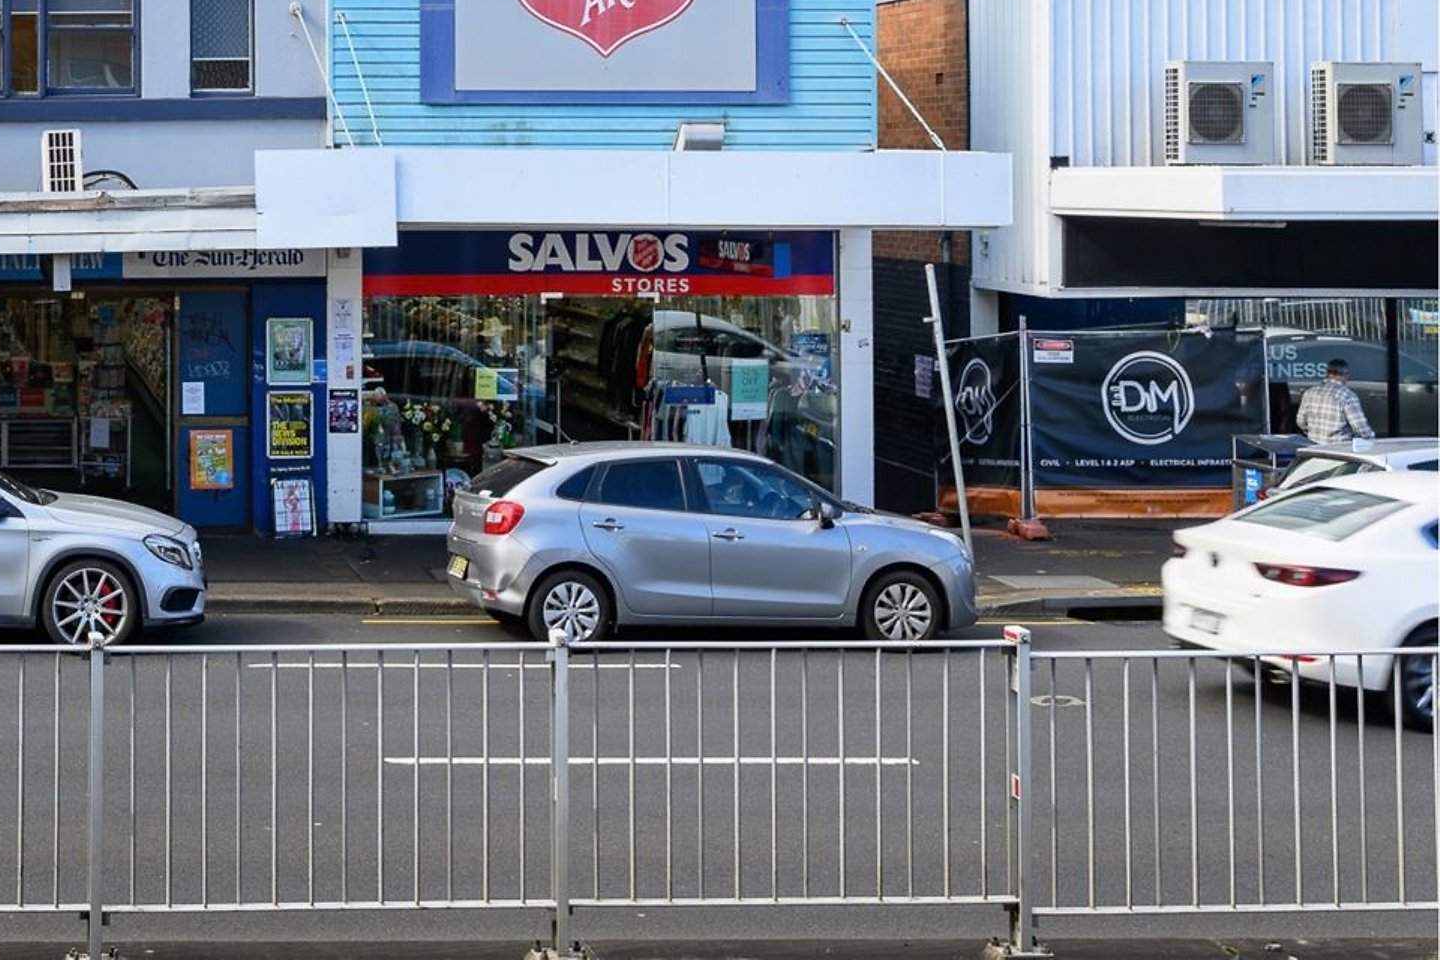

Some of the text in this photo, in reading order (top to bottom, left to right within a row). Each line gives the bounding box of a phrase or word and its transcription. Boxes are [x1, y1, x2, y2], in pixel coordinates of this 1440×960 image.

[152, 251, 190, 268] The
[508, 233, 690, 273] SALVOS
[718, 240, 751, 262] SALVOS
[611, 278, 690, 292] STORES
[1266, 344, 1298, 361] US
